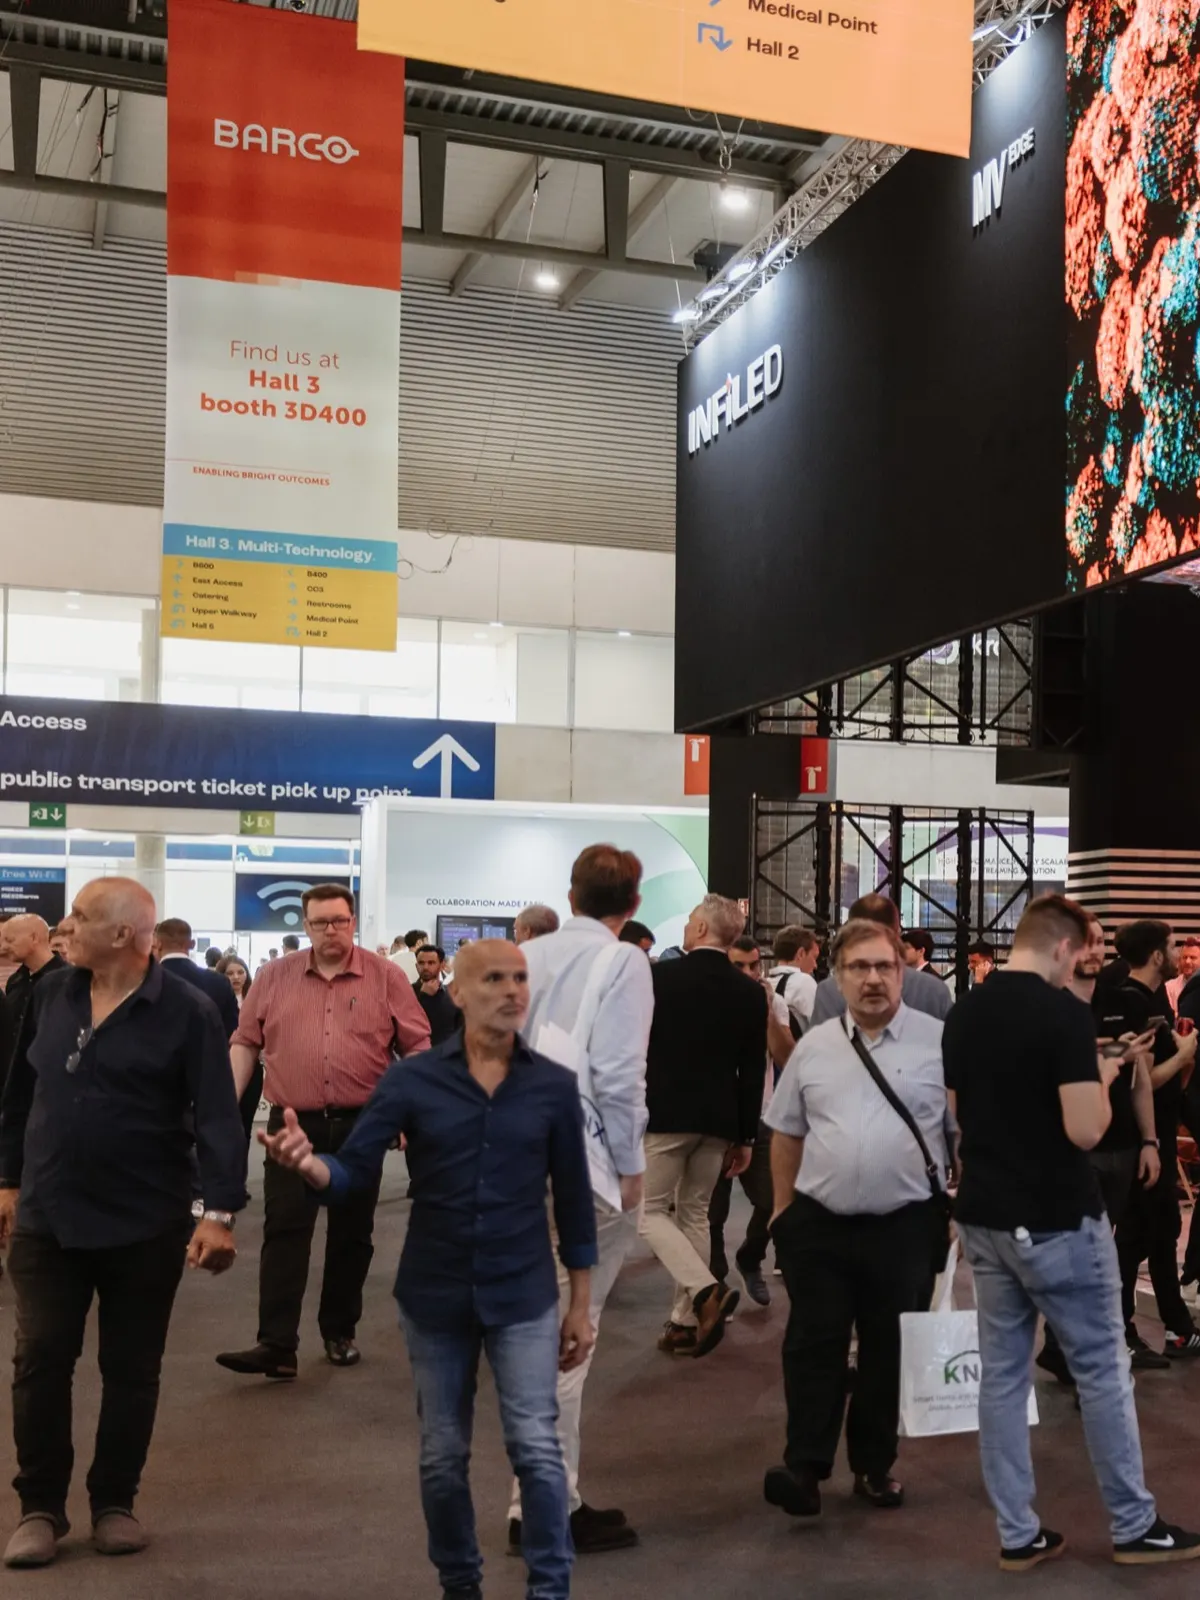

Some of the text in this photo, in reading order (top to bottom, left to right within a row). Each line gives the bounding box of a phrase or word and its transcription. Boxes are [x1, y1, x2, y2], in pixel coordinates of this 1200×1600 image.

[748, 0, 877, 34] Medical Point
[747, 37, 799, 60] Hall 2
[214, 118, 359, 164] BARCO
[972, 127, 1035, 227] MV EDGE
[230, 340, 340, 369] Find us at
[249, 369, 320, 394] Hall 3
[200, 393, 367, 427] booth 3D400
[193, 466, 331, 486] ENABLING BRIGHT OUTCOMES
[185, 535, 216, 549] Hall
[213, 578, 243, 587] Access
[192, 591, 229, 602] Catering
[306, 600, 352, 610] Restrooms
[192, 607, 257, 620] Upper Walkway
[306, 614, 359, 625] Medical Point
[191, 622, 207, 630] Hall
[306, 629, 321, 638] Hall
[0, 710, 88, 732] Access
[1, 769, 73, 790] public
[77, 773, 197, 796] transport
[201, 778, 267, 797] ticket
[271, 781, 318, 801] pick
[322, 786, 351, 803] up
[426, 898, 496, 908] COLLABORATION
[498, 900, 521, 908] MADE
[944, 1363, 981, 1385] KN
